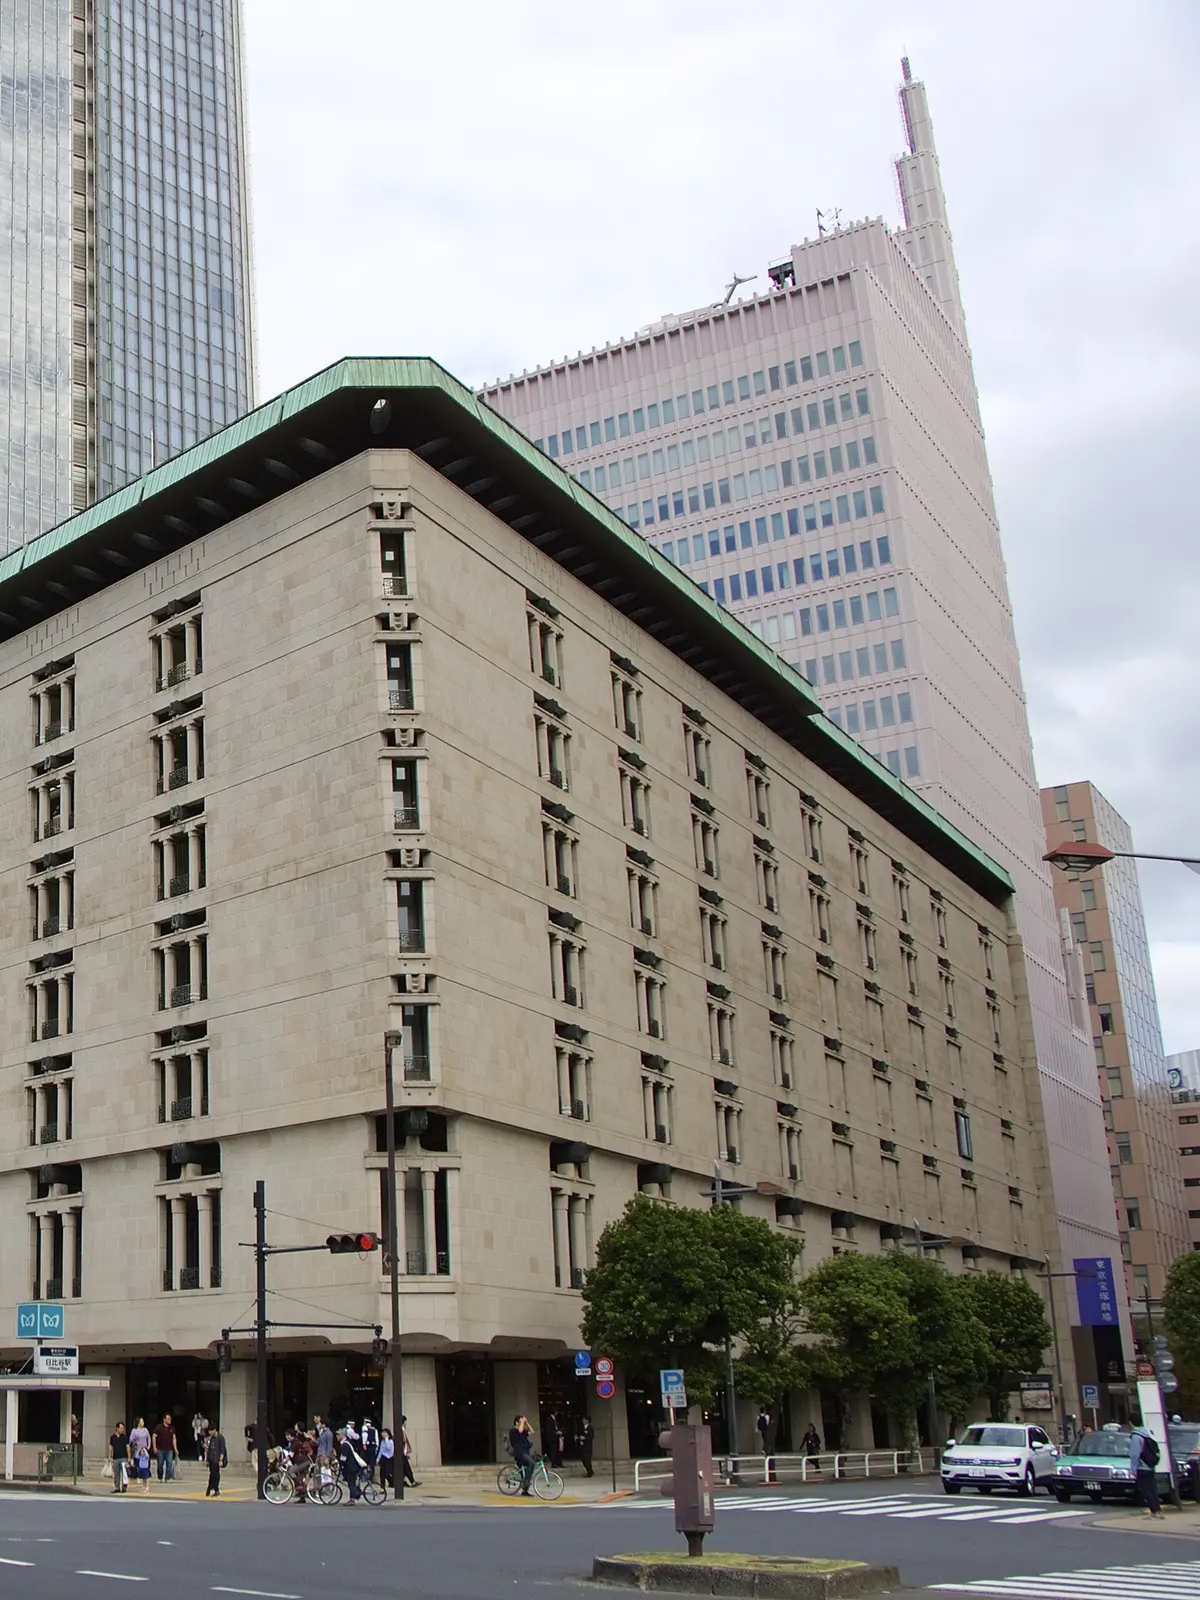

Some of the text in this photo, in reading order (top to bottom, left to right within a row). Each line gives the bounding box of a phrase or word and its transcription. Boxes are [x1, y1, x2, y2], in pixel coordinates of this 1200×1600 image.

[45, 1359, 71, 1367] 日比谷駅
[599, 1362, 610, 1370] 30
[663, 1371, 682, 1392] P
